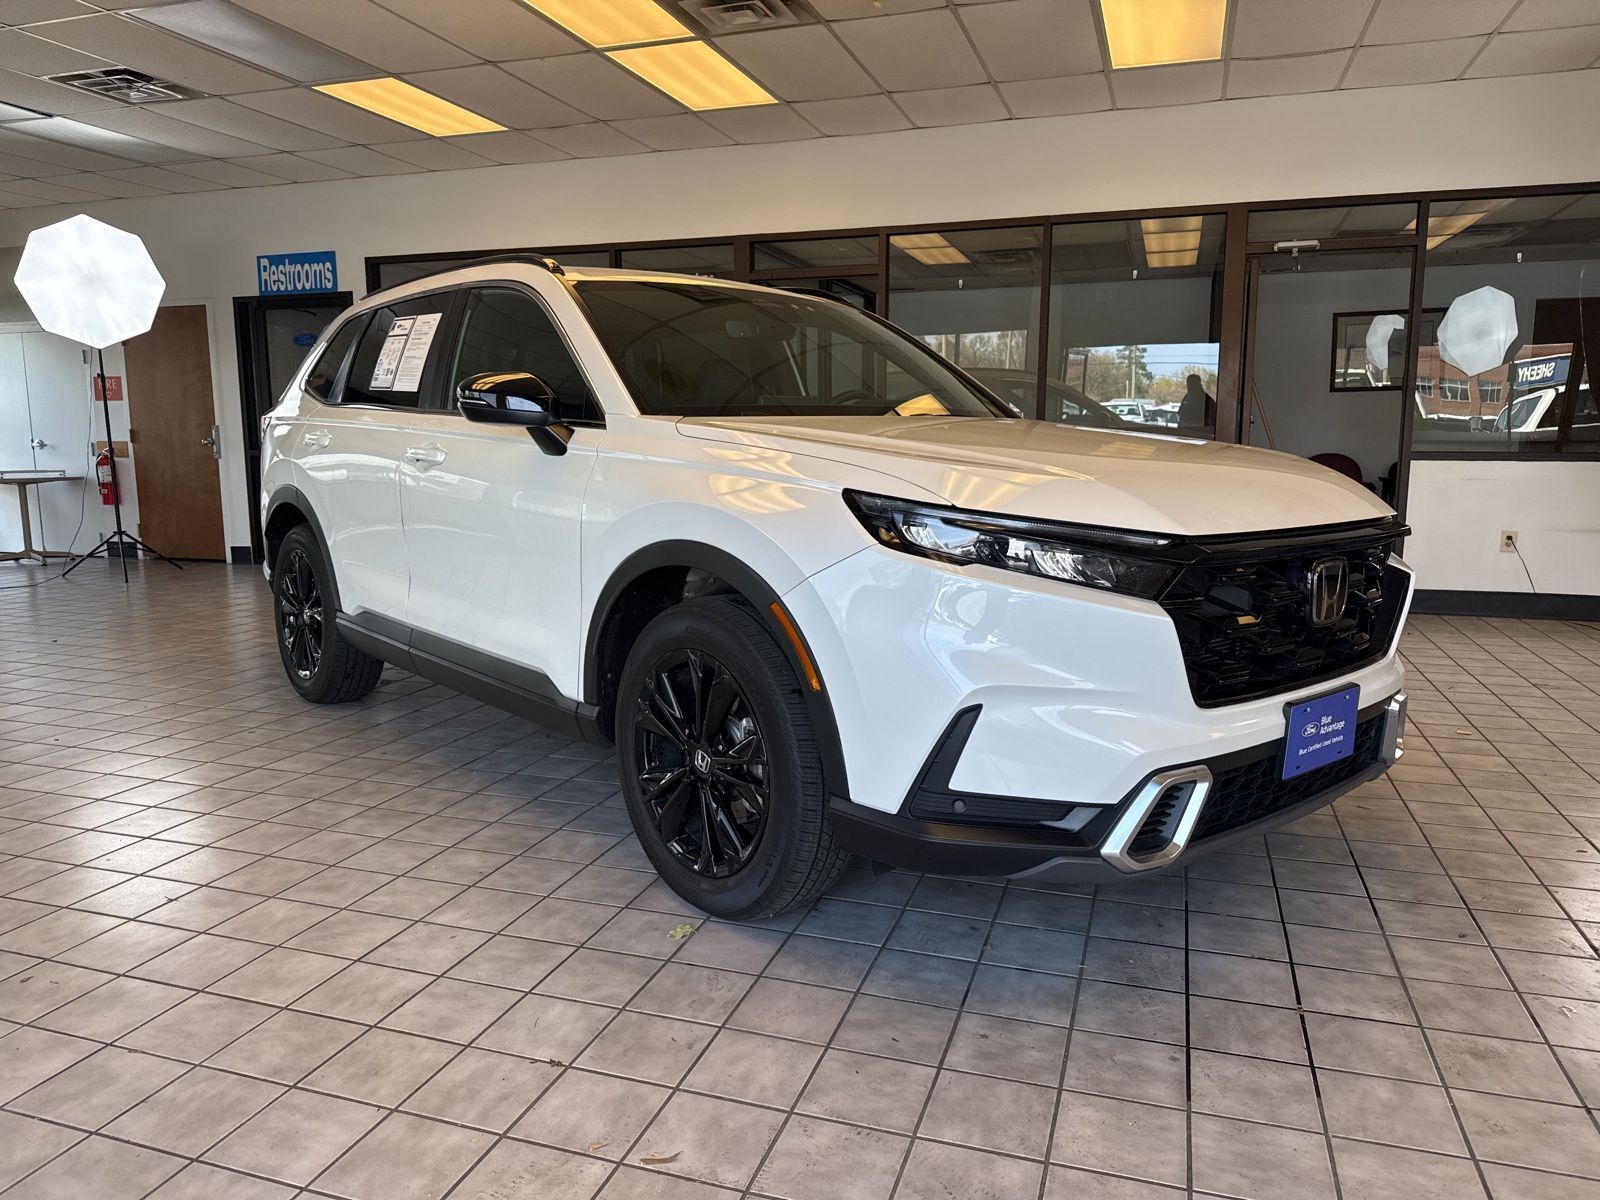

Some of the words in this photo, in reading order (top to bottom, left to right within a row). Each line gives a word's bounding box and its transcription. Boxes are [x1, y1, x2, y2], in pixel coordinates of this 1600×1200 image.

[259, 258, 333, 291] Restrooms
[98, 379, 117, 390] FRE
[1320, 715, 1332, 725] Blue
[1320, 720, 1345, 734] Advantage
[1308, 741, 1321, 752] Certified
